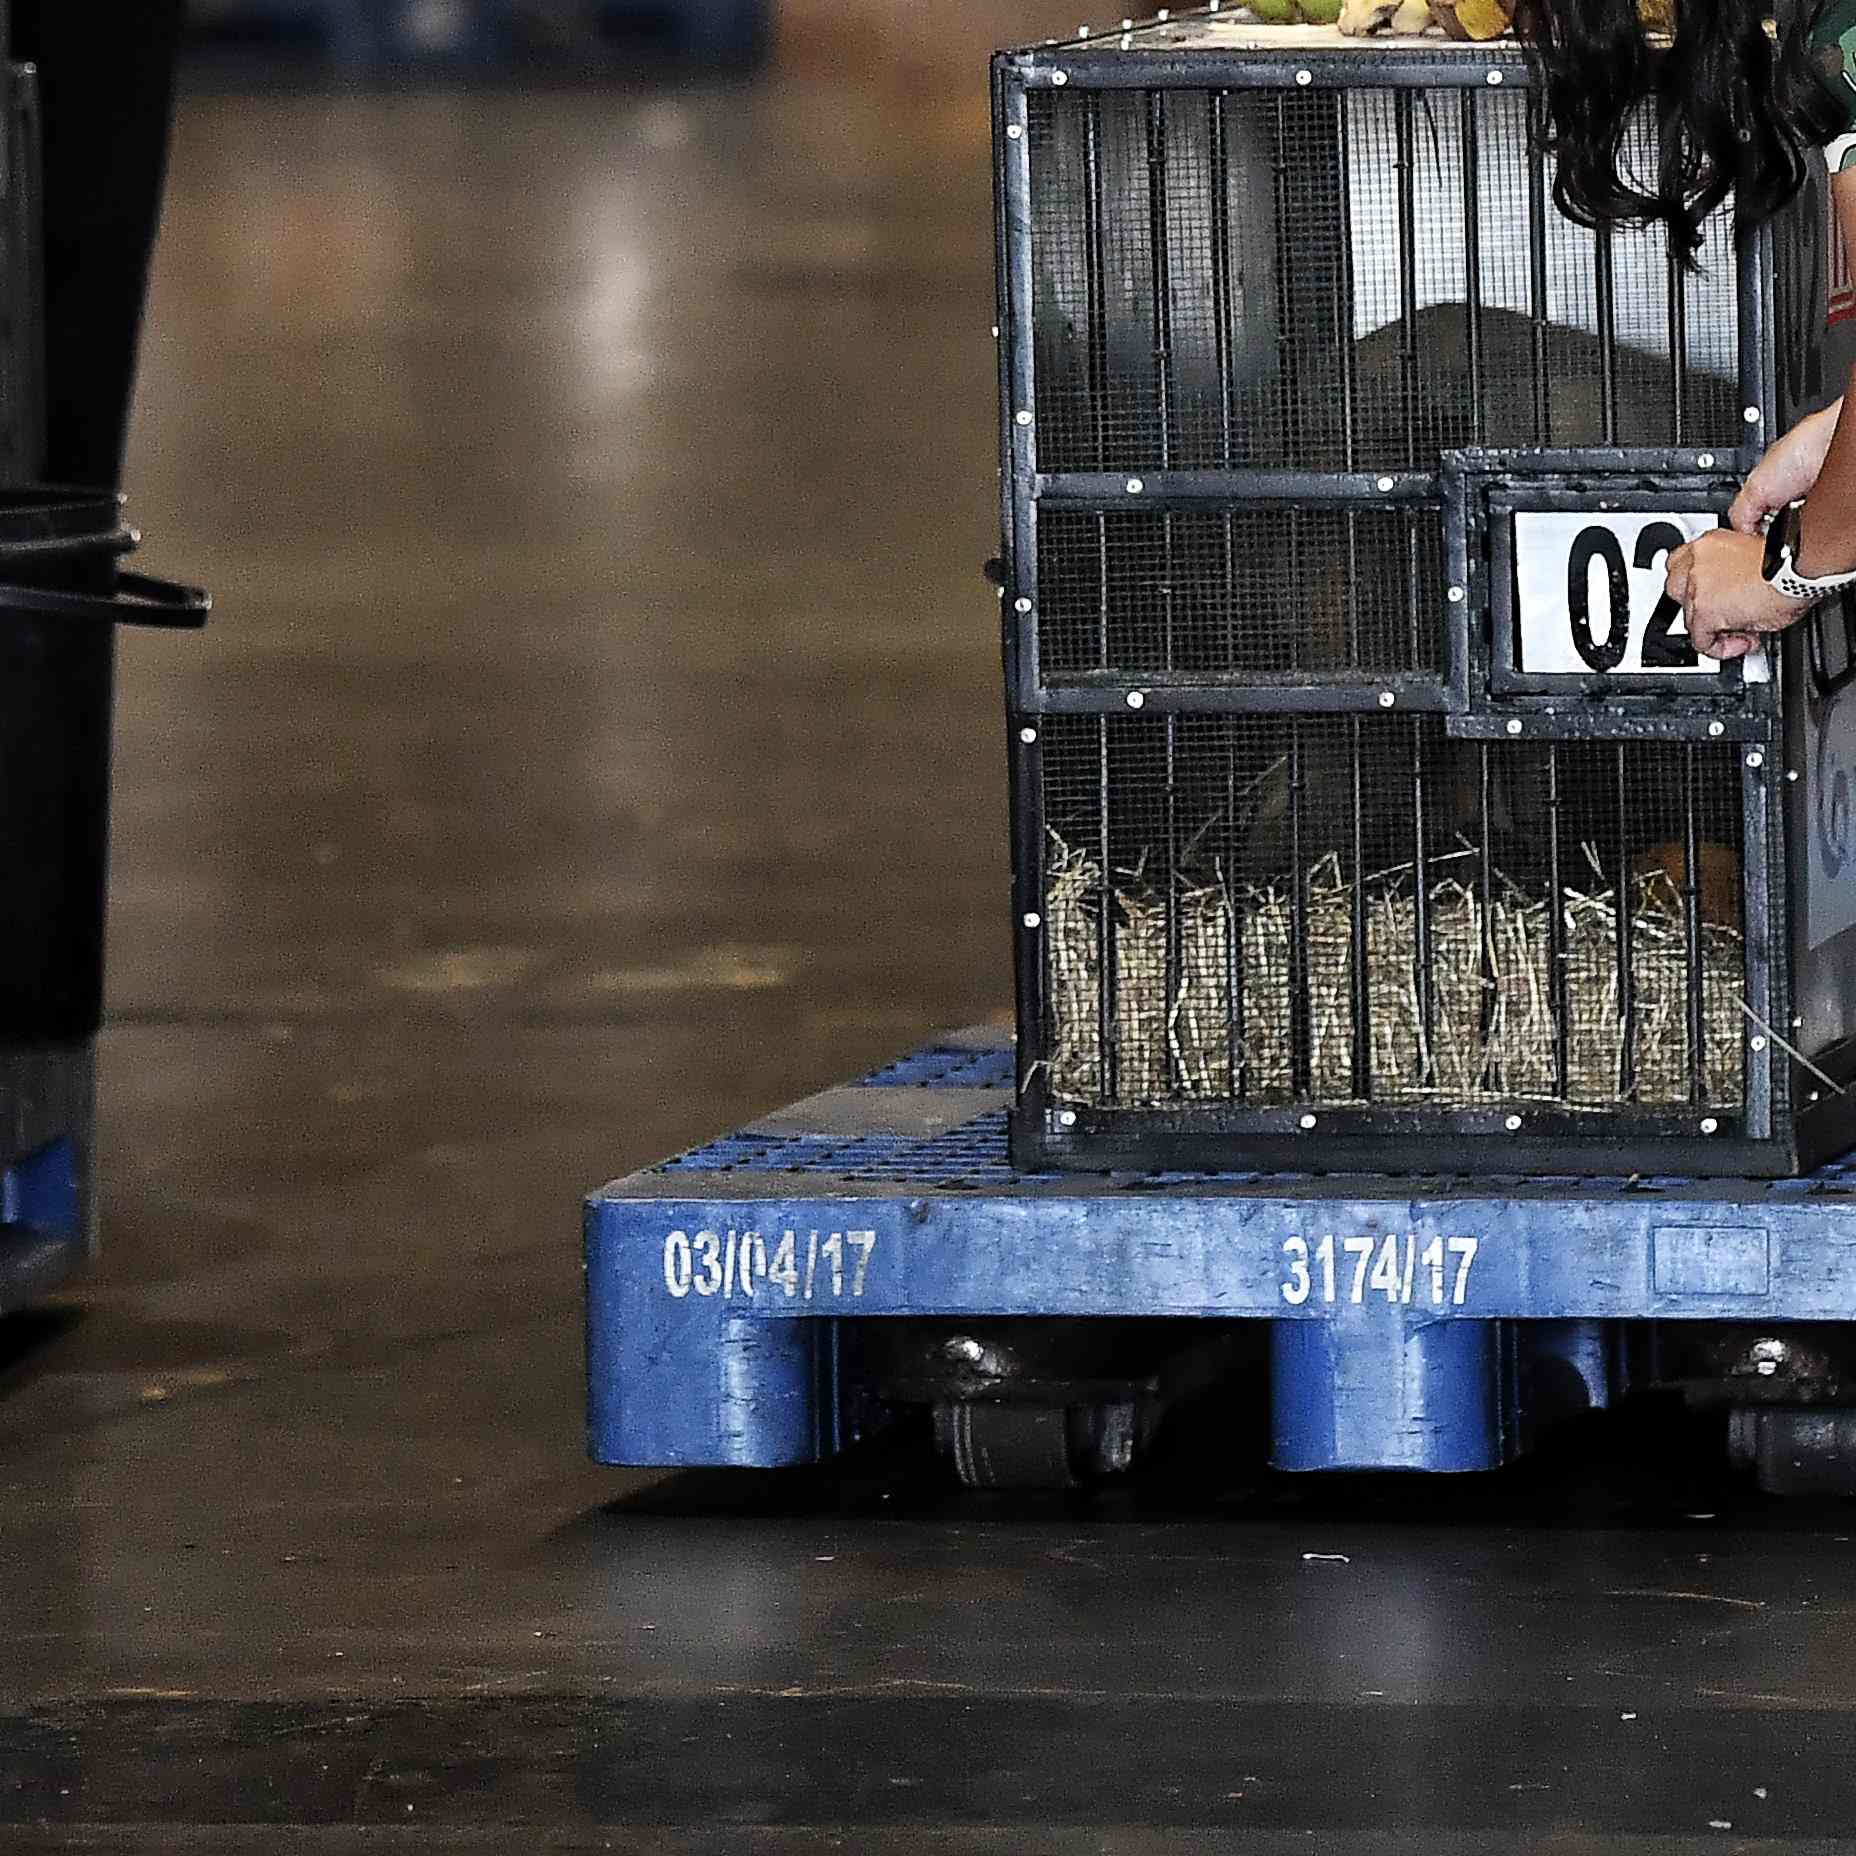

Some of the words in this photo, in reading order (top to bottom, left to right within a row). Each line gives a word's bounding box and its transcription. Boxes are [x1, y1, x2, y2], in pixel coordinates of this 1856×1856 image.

[1567, 521, 1700, 672] 02
[663, 1229, 877, 1299] 03/04/17
[1281, 1235, 1479, 1305] 3174/17
